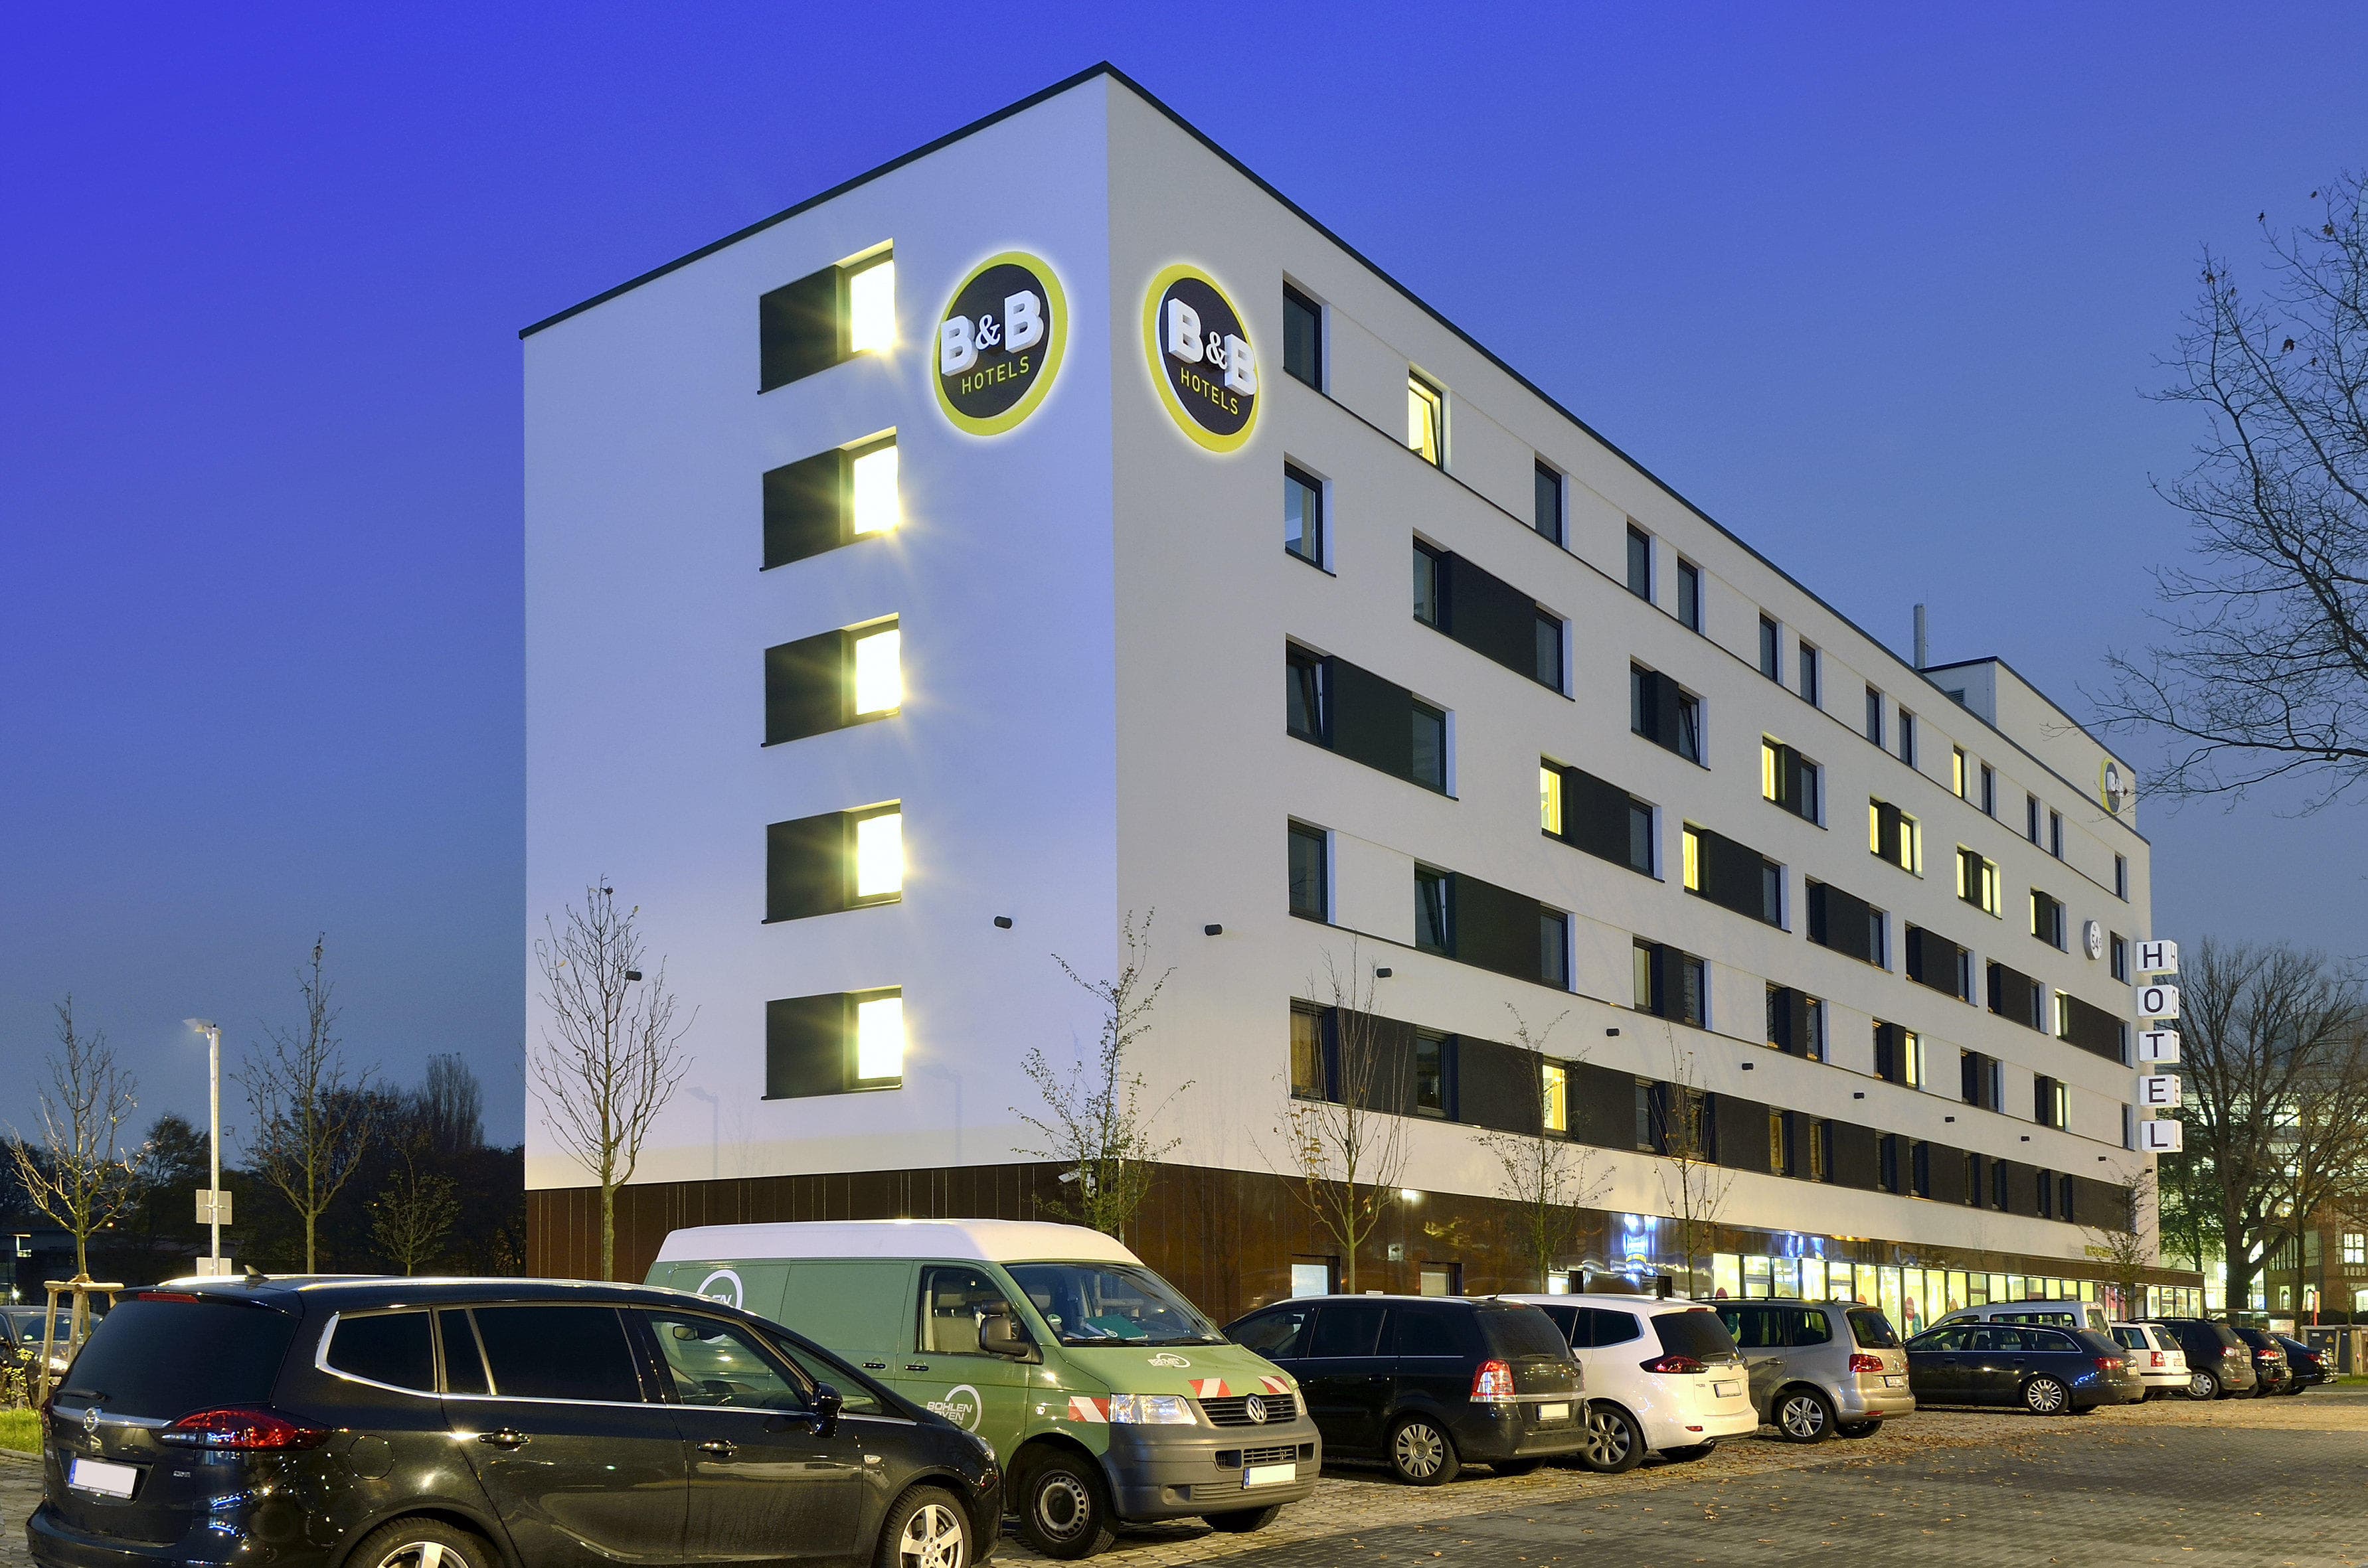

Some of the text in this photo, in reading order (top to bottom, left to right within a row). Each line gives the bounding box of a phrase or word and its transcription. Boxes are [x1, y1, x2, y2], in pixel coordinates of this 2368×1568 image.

[940, 289, 1045, 377] B&B
[1167, 298, 1258, 397] B&B
[962, 356, 1029, 394] HOTELS
[1181, 367, 1239, 416] HOTELS
[2143, 943, 2168, 1147] HOTEL
[926, 1401, 973, 1413] BOHLEN
